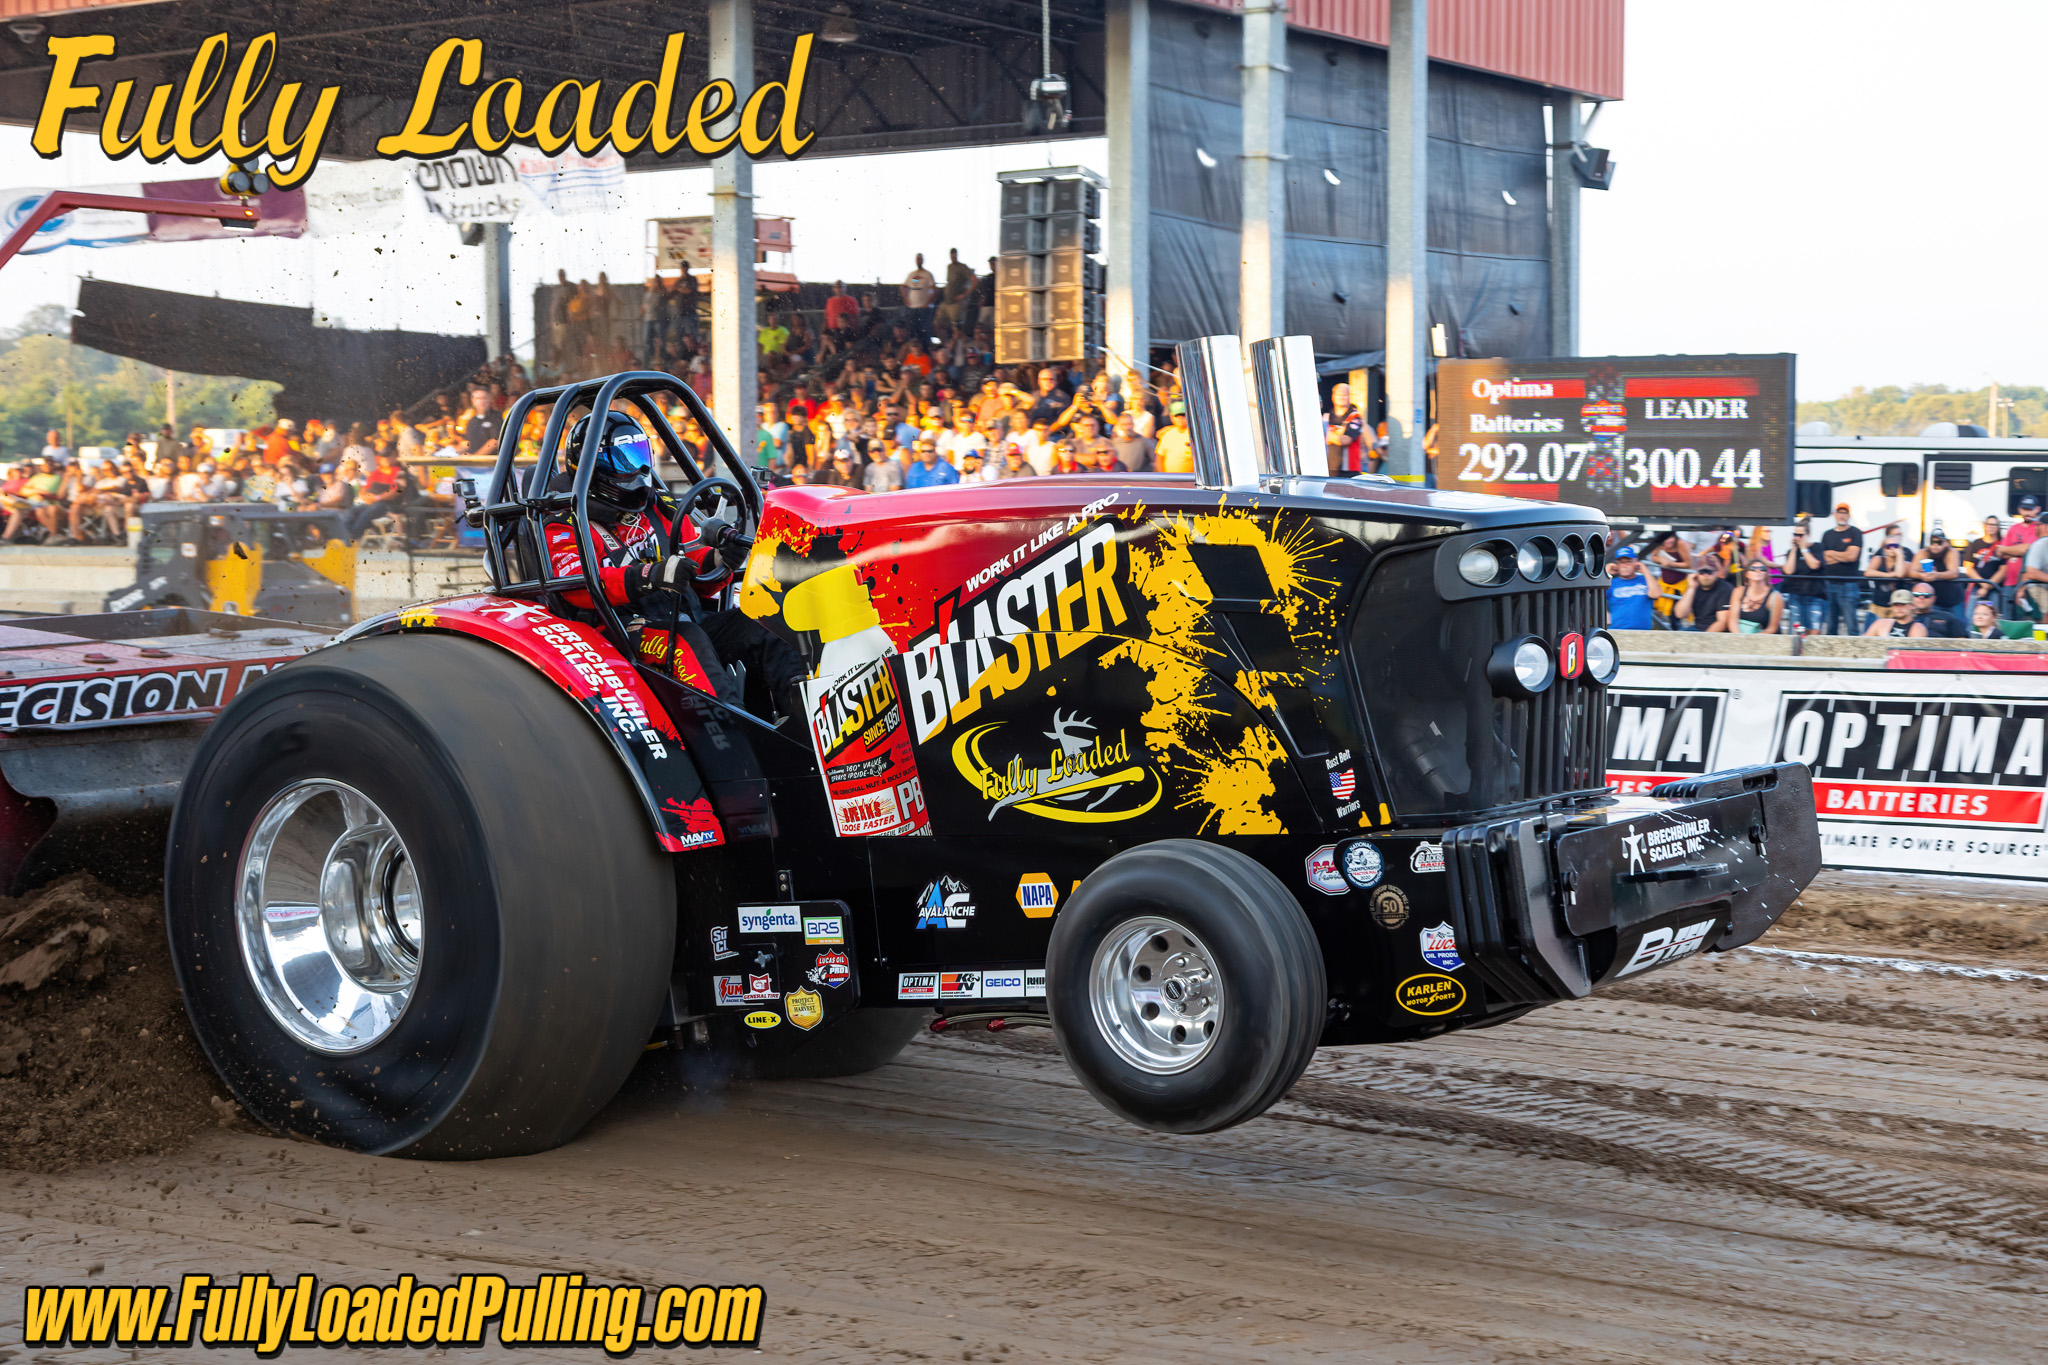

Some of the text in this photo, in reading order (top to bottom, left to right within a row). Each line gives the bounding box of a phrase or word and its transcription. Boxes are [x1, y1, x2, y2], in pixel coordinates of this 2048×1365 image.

[1471, 377, 1554, 404] Optima
[1644, 398, 1749, 420] LEADER
[1469, 412, 1565, 434] Batteries
[1457, 442, 1592, 483] 292.07
[1624, 448, 1765, 489] 300.44
[966, 492, 1120, 592] WORK IT LIKE A PRO
[640, 634, 668, 659] ully
[532, 626, 604, 692] SCALES,
[601, 697, 636, 740] INC.
[548, 622, 668, 760] BRECHBUHLER
[863, 718, 887, 746] SINCE
[1605, 705, 1704, 763] MA
[1783, 710, 2044, 777] OPTIMA
[979, 728, 1131, 801] Fully Loaded
[1325, 748, 1352, 770] Rust Belt
[866, 780, 880, 791] NUT
[1605, 780, 1653, 794] IES
[897, 776, 925, 821] PB
[1335, 799, 1361, 819] Warriors
[1826, 788, 1989, 817] BATTERIES
[841, 823, 861, 832] LOOSE
[863, 814, 896, 830] FASTER
[1649, 836, 1705, 863] SCALES, INC.
[1890, 836, 1956, 852] POWER
[1965, 840, 2040, 857] SOURCE
[1022, 884, 1054, 906] NAPA
[918, 905, 976, 922] AVALANCHE
[1382, 900, 1398, 913] 50
[742, 912, 795, 931] syngenta
[807, 921, 840, 935] BRS
[819, 957, 835, 965] LUCAS
[903, 977, 934, 987] OPTIMA
[985, 977, 1021, 988] GEICO
[1407, 980, 1452, 998] KARLEN
[792, 996, 815, 1005] PROTECT
[793, 1005, 816, 1013] HARVEST
[747, 1015, 777, 1024] LINE-X
